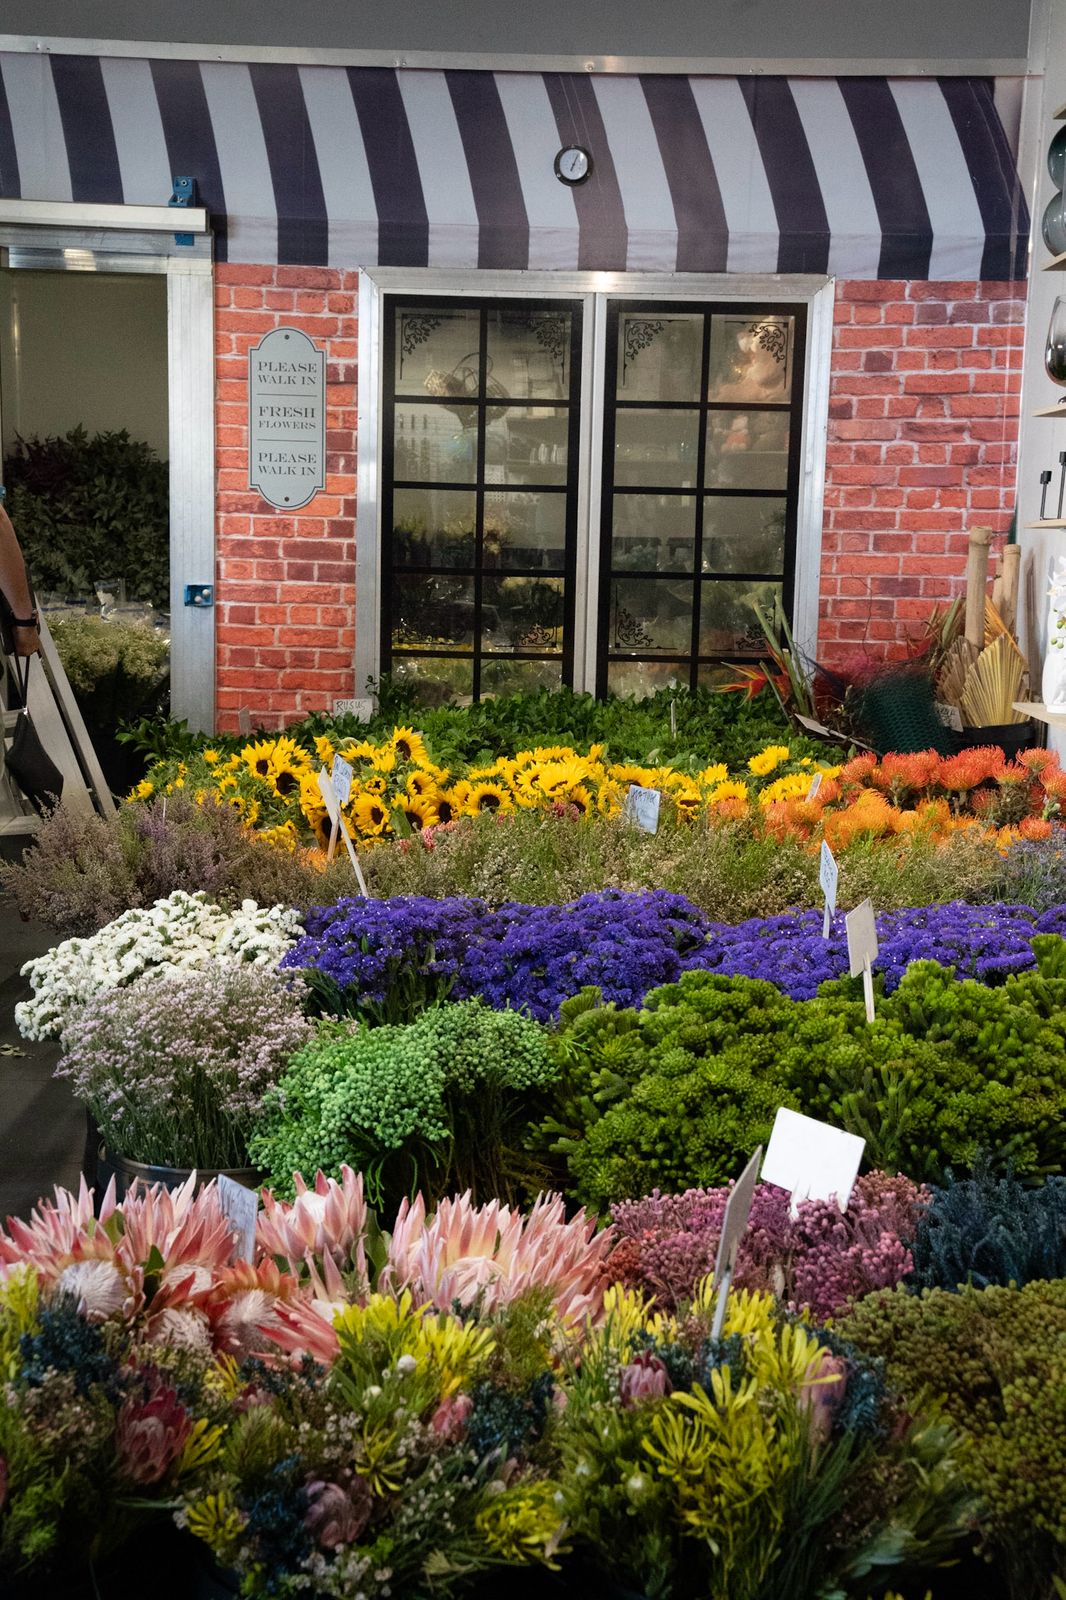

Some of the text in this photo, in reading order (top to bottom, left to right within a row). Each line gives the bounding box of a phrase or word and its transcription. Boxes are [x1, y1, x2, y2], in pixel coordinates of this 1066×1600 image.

[258, 361, 317, 373] PLEASE
[258, 374, 317, 386] WALK IN
[259, 406, 316, 418] FRESH
[259, 420, 316, 430] FLOWERS
[258, 452, 317, 464] PLEASE
[258, 465, 317, 476] WALK IN
